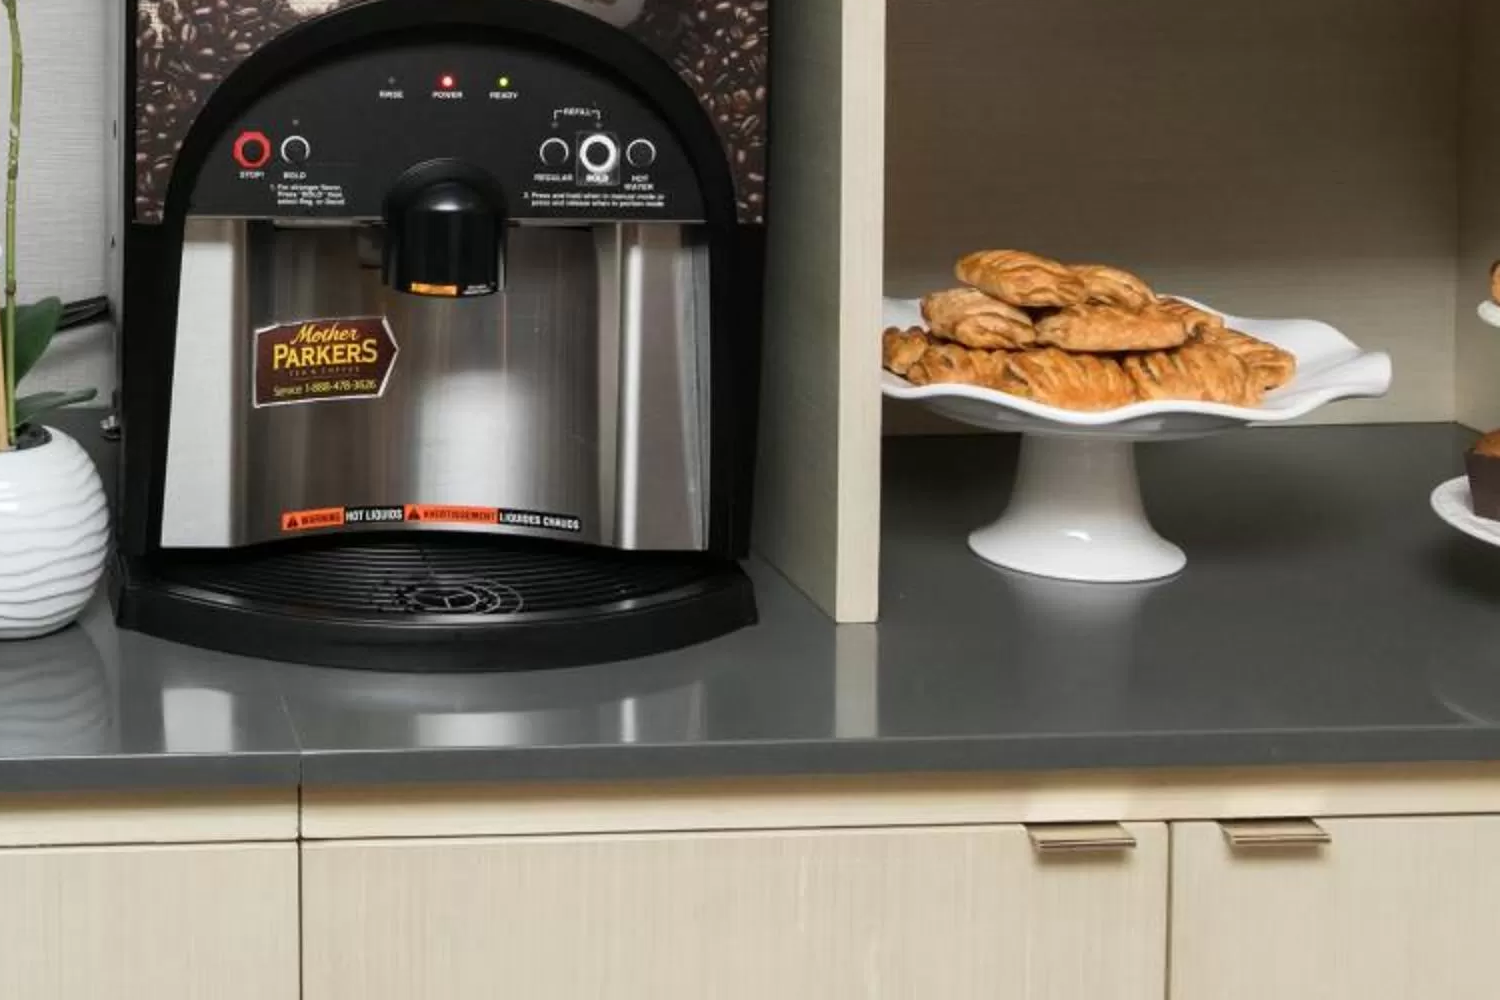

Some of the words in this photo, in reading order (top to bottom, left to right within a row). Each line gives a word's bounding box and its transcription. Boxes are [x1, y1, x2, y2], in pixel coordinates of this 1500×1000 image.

[432, 91, 463, 99] POWER
[488, 91, 519, 100] READY
[283, 171, 307, 179] BOLD
[533, 173, 573, 181] REGULAR
[623, 183, 654, 191] WATER
[290, 322, 361, 344] Mother
[272, 338, 378, 370] PARKERS
[345, 509, 364, 522] HOT
[366, 509, 403, 521] LIQUIDS
[543, 516, 581, 531] CHAUDS
